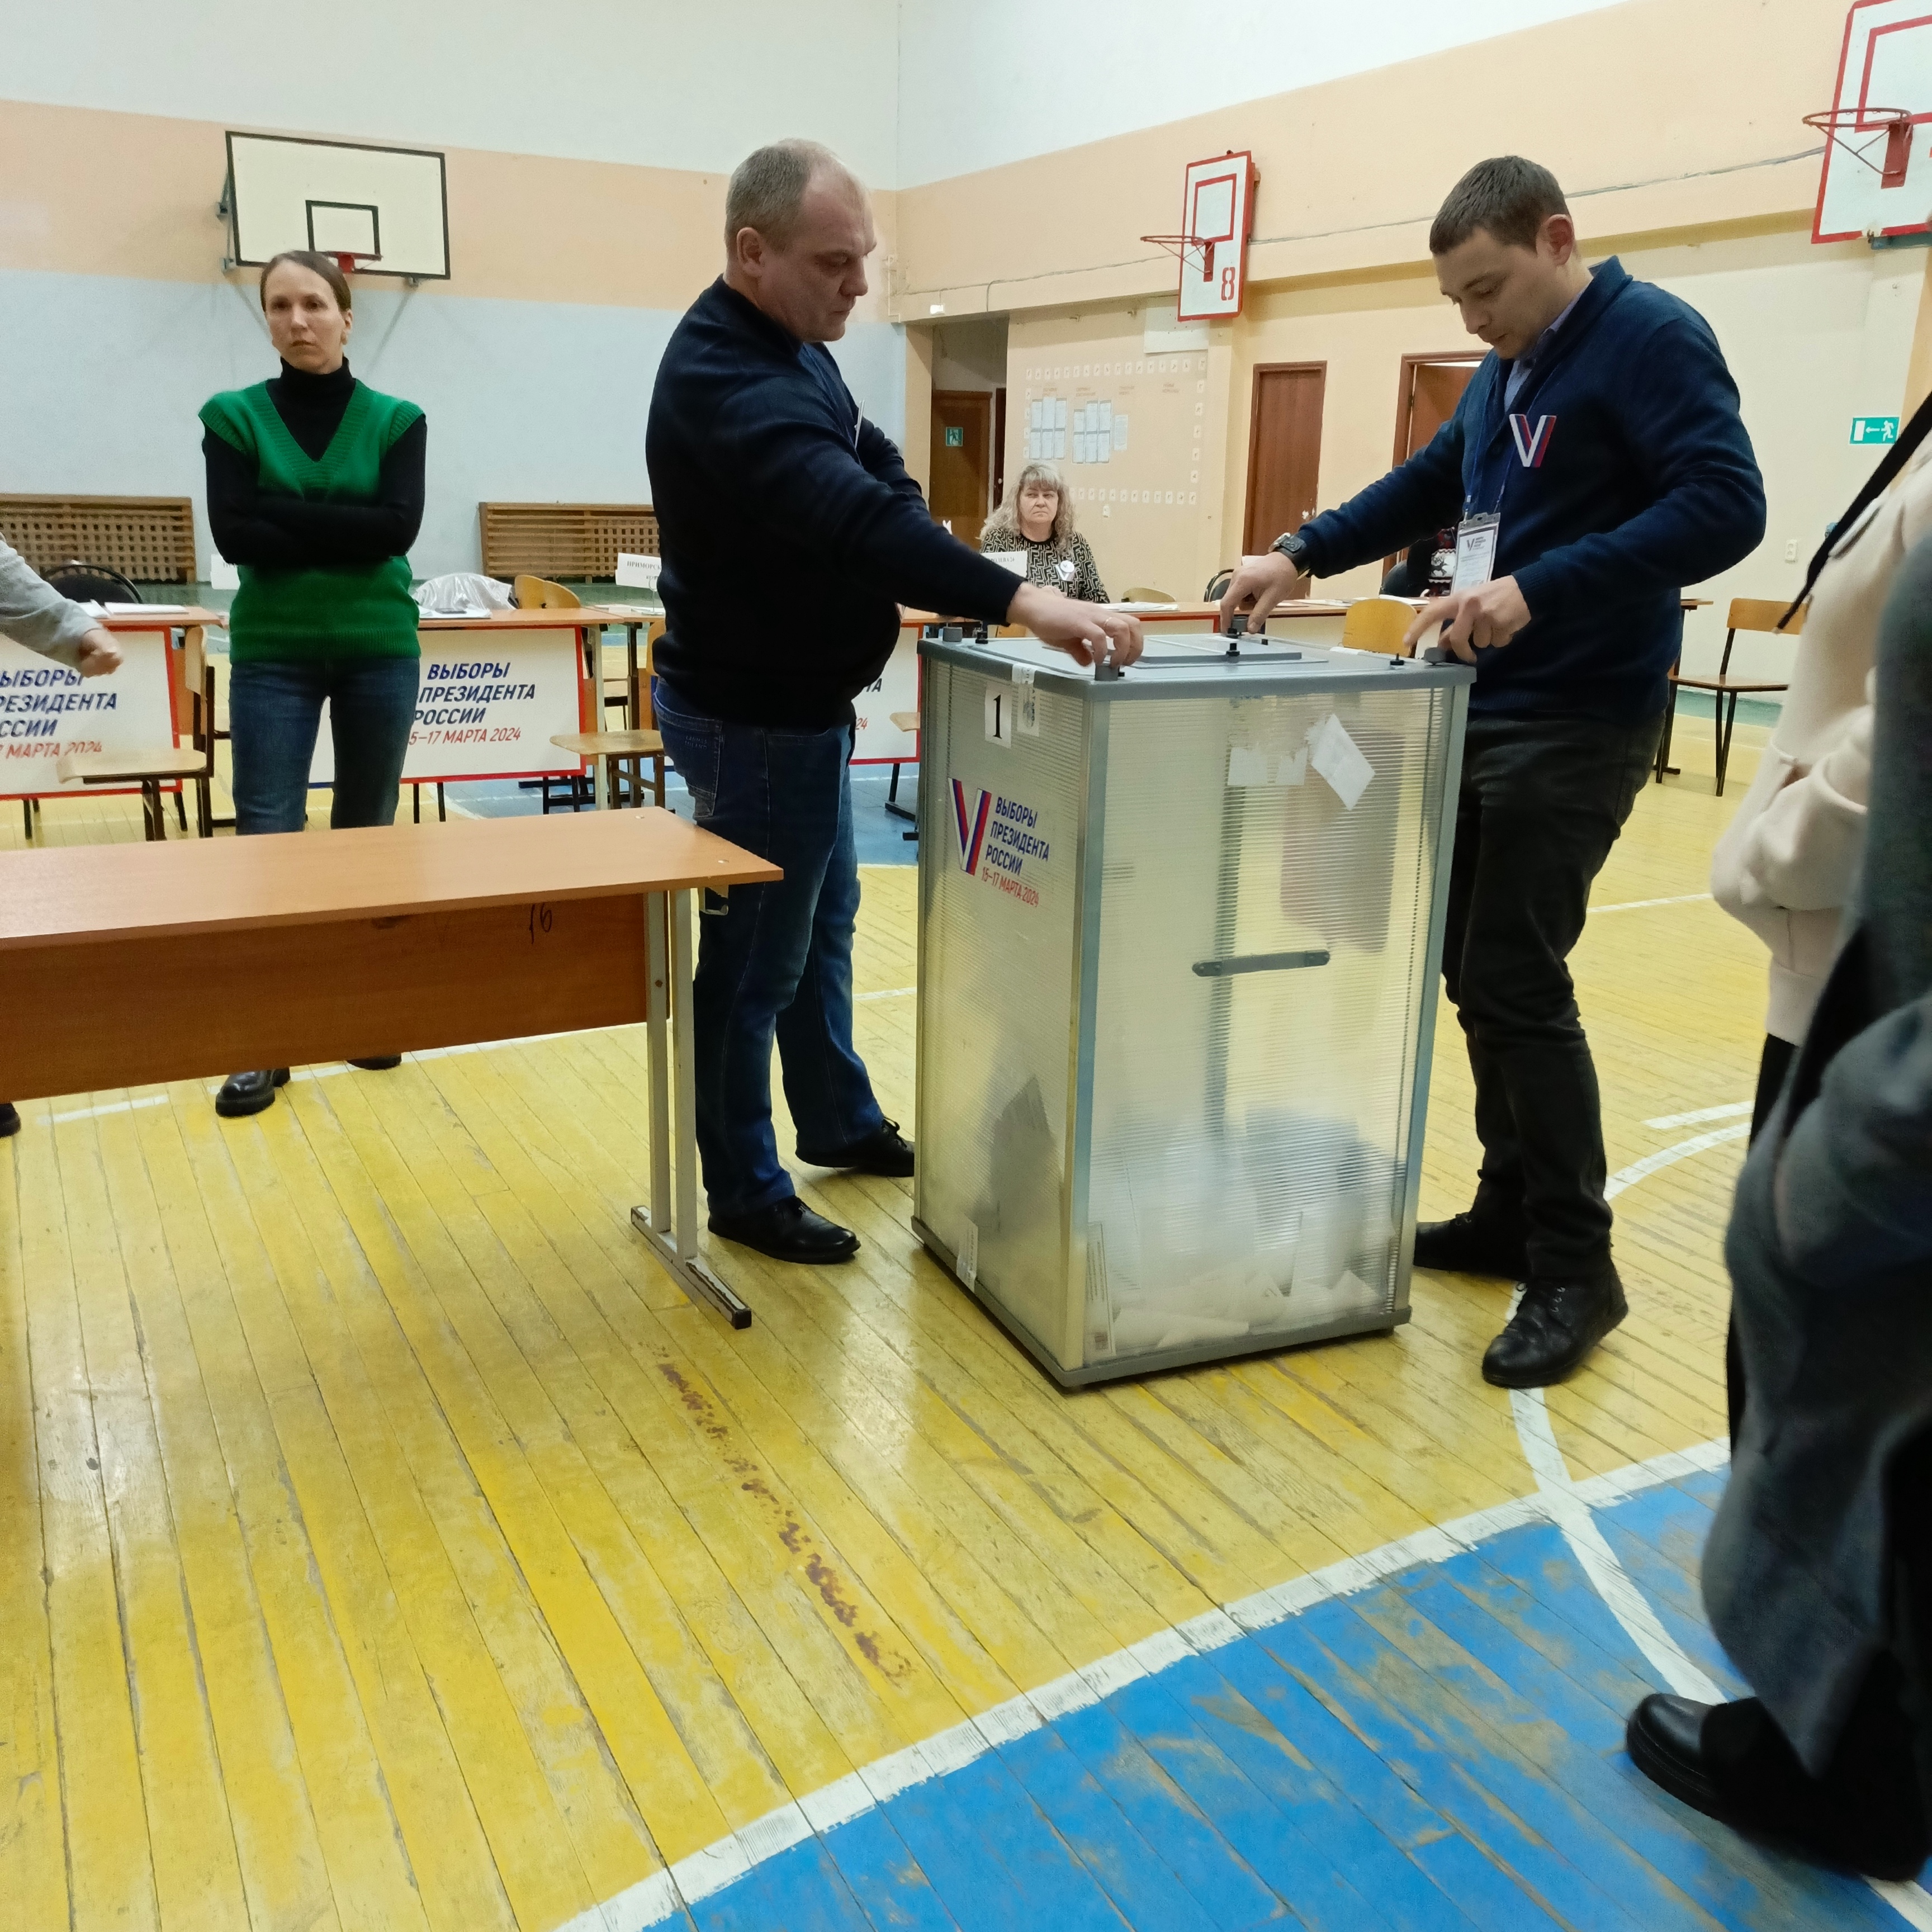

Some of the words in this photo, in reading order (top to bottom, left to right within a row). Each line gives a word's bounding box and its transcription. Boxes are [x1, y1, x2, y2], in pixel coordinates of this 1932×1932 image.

[1221, 267, 1235, 301] 8
[427, 662, 511, 680] ВЫБОРЫ
[419, 684, 536, 703] ПРЕЗИДЕНТА
[414, 708, 486, 725] РОССИИ
[993, 694, 1002, 739] 1
[6, 743, 60, 759] МАРТА
[443, 729, 487, 744] МАРТА
[489, 727, 521, 742] 2024
[996, 797, 1038, 828] ВЫБОРЫ
[990, 821, 1050, 861] ПРЕЗИДЕНТА
[986, 844, 1023, 875] РОССИИ
[999, 875, 1022, 899] МАРТА
[1022, 887, 1039, 907] 2024
